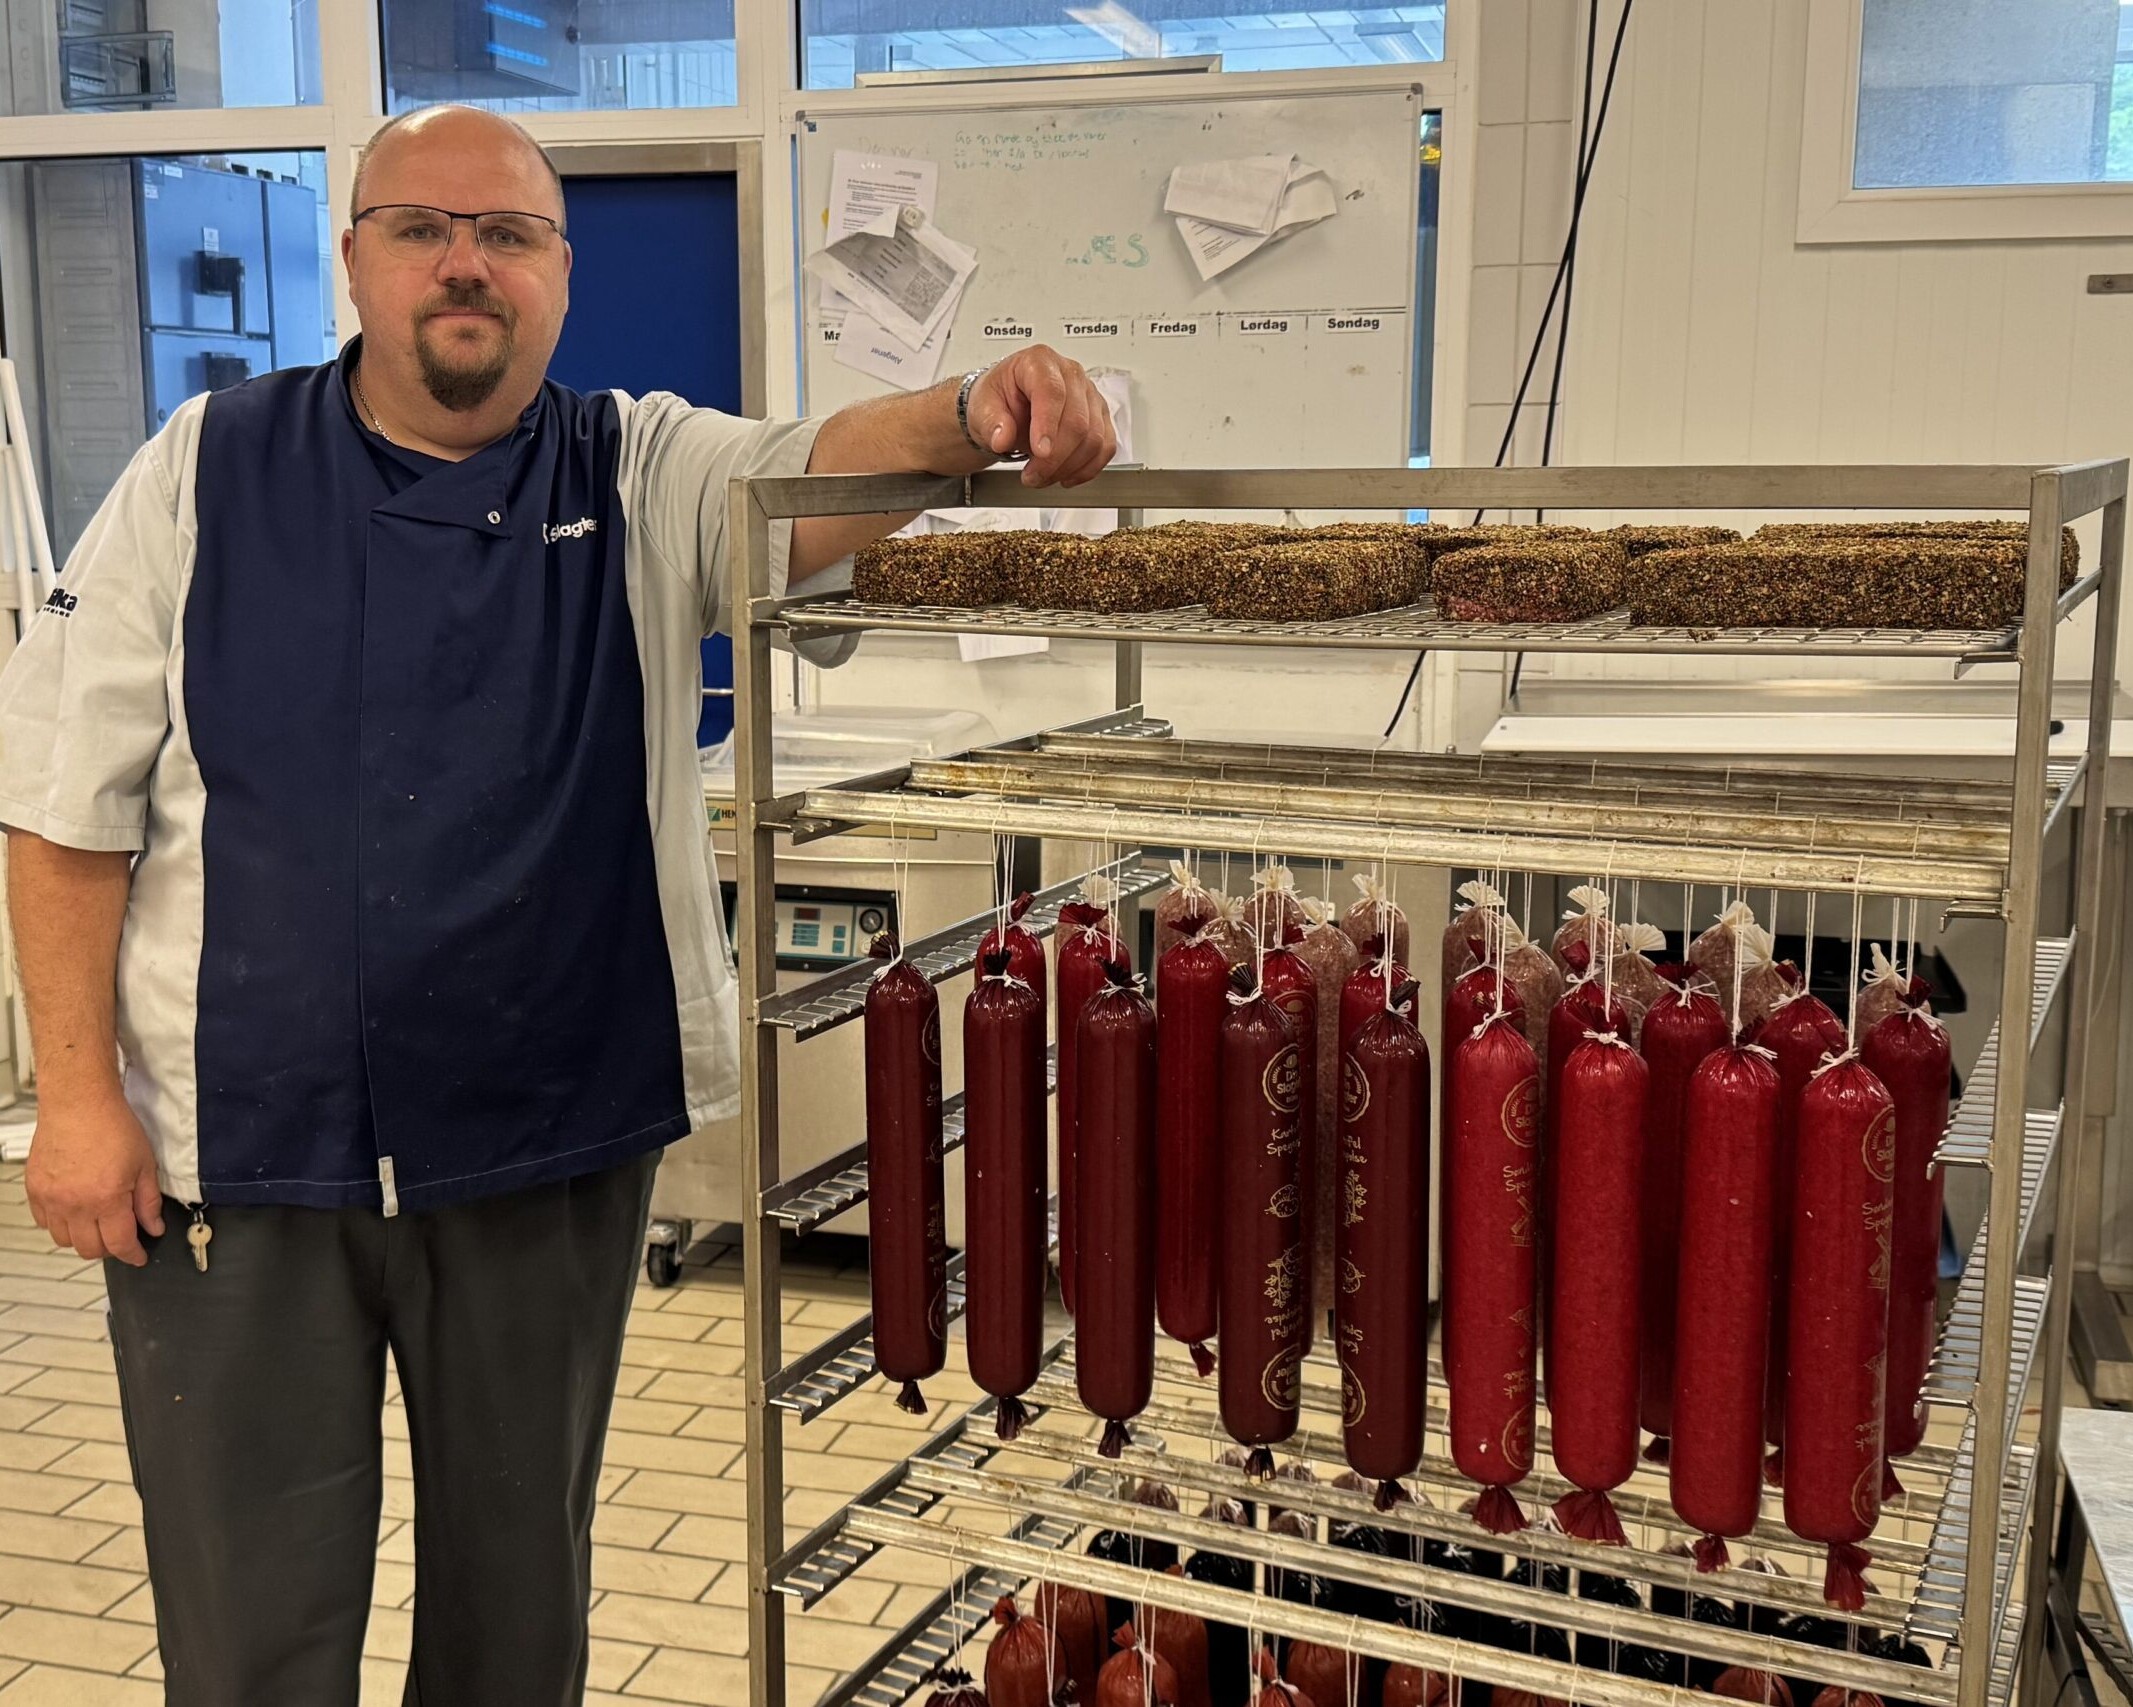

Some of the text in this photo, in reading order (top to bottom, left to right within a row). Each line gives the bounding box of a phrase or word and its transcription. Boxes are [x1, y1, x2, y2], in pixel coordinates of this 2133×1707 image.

[1064, 323, 1118, 335] Torsdag
[1150, 322, 1197, 334] Fredag
[1240, 319, 1288, 331] Lørdag
[1327, 317, 1380, 330] Søndag
[984, 325, 1032, 337] Onsdag
[721, 809, 737, 819] HEN
